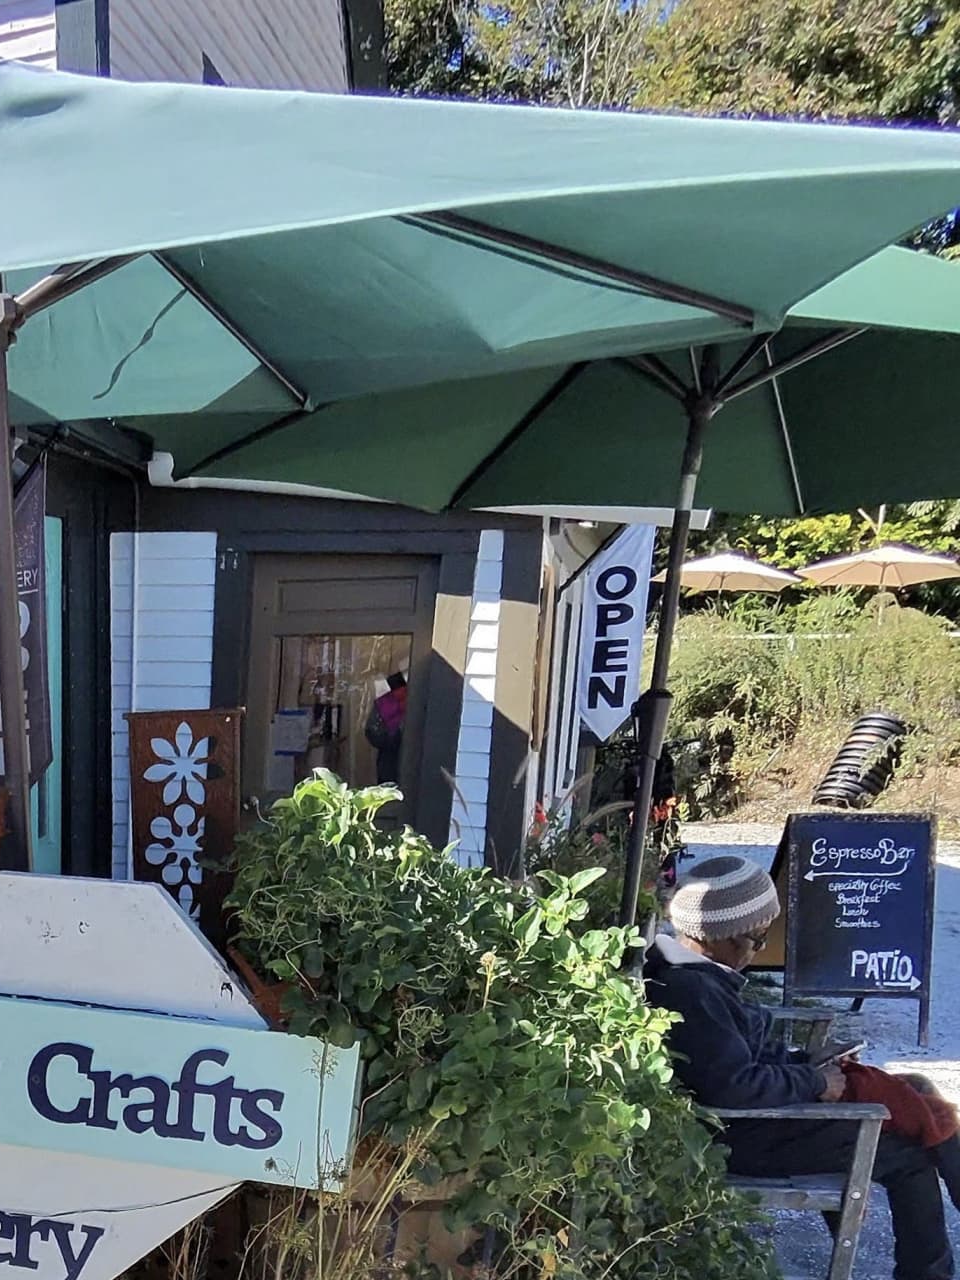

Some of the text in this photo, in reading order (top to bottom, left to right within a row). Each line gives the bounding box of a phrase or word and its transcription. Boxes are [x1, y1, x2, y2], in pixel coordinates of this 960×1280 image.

[588, 566, 637, 709] OPEN
[810, 838, 916, 868] Espresso Bar
[27, 1042, 284, 1150] Crafts
